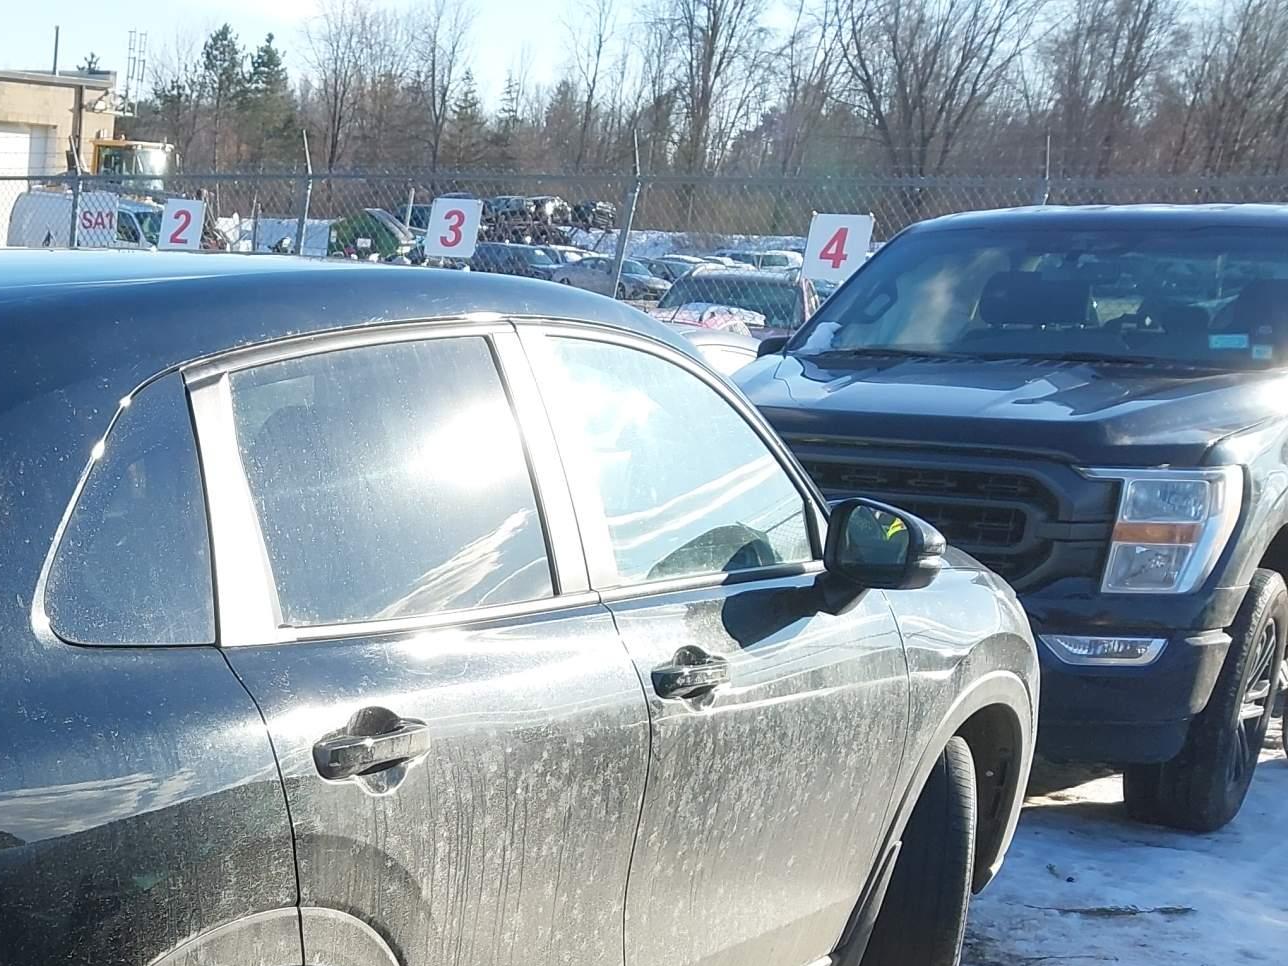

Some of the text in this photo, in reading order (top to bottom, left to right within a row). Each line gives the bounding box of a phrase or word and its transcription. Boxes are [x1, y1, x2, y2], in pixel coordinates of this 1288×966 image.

[81, 210, 114, 230] SA1
[169, 209, 192, 244] 2
[440, 209, 465, 247] 3
[819, 227, 848, 268] 4
